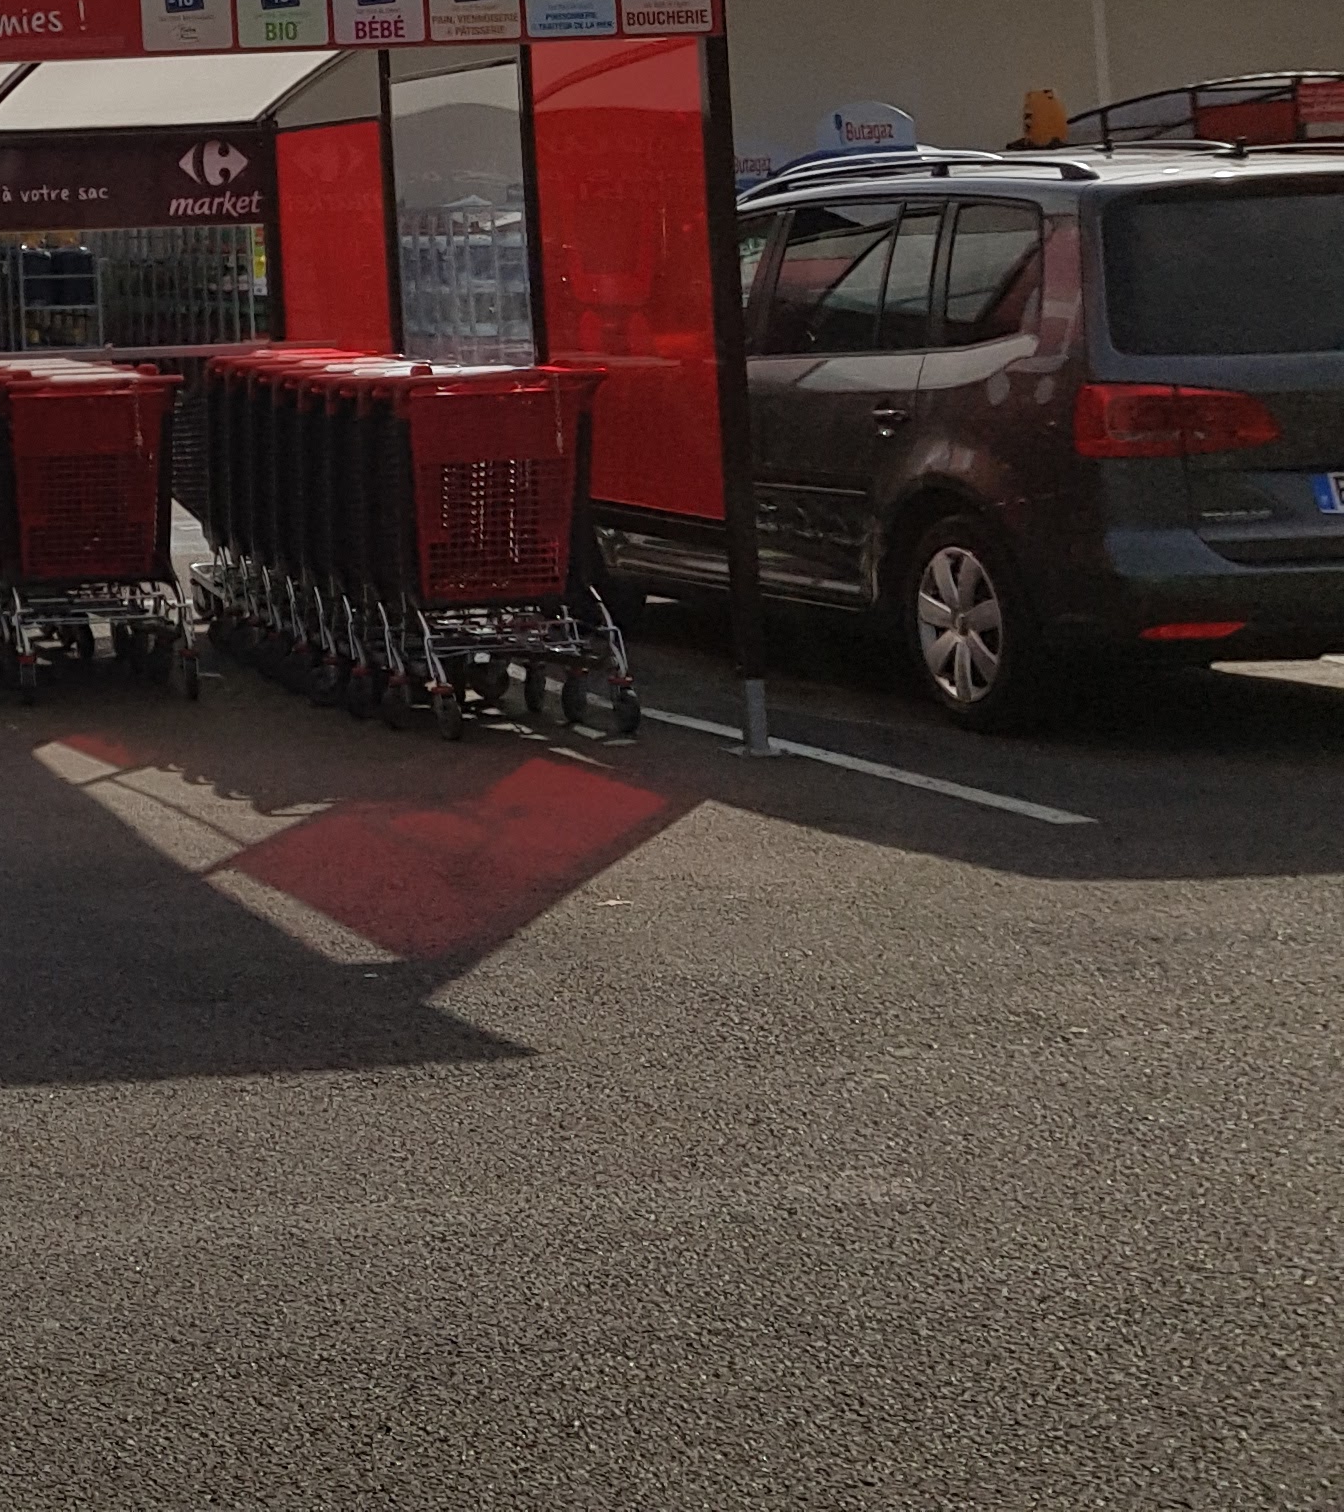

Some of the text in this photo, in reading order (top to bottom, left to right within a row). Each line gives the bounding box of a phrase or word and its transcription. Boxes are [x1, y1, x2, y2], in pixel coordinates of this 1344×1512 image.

[78, 0, 86, 31] !
[627, 9, 709, 27] BOUCHERIE
[265, 21, 297, 41] BIO
[354, 15, 406, 40] BÉBÉ
[845, 121, 894, 143] Butagaz
[2, 185, 13, 203] à
[20, 184, 70, 203] votre
[78, 186, 109, 201] sac
[169, 190, 264, 217] market
